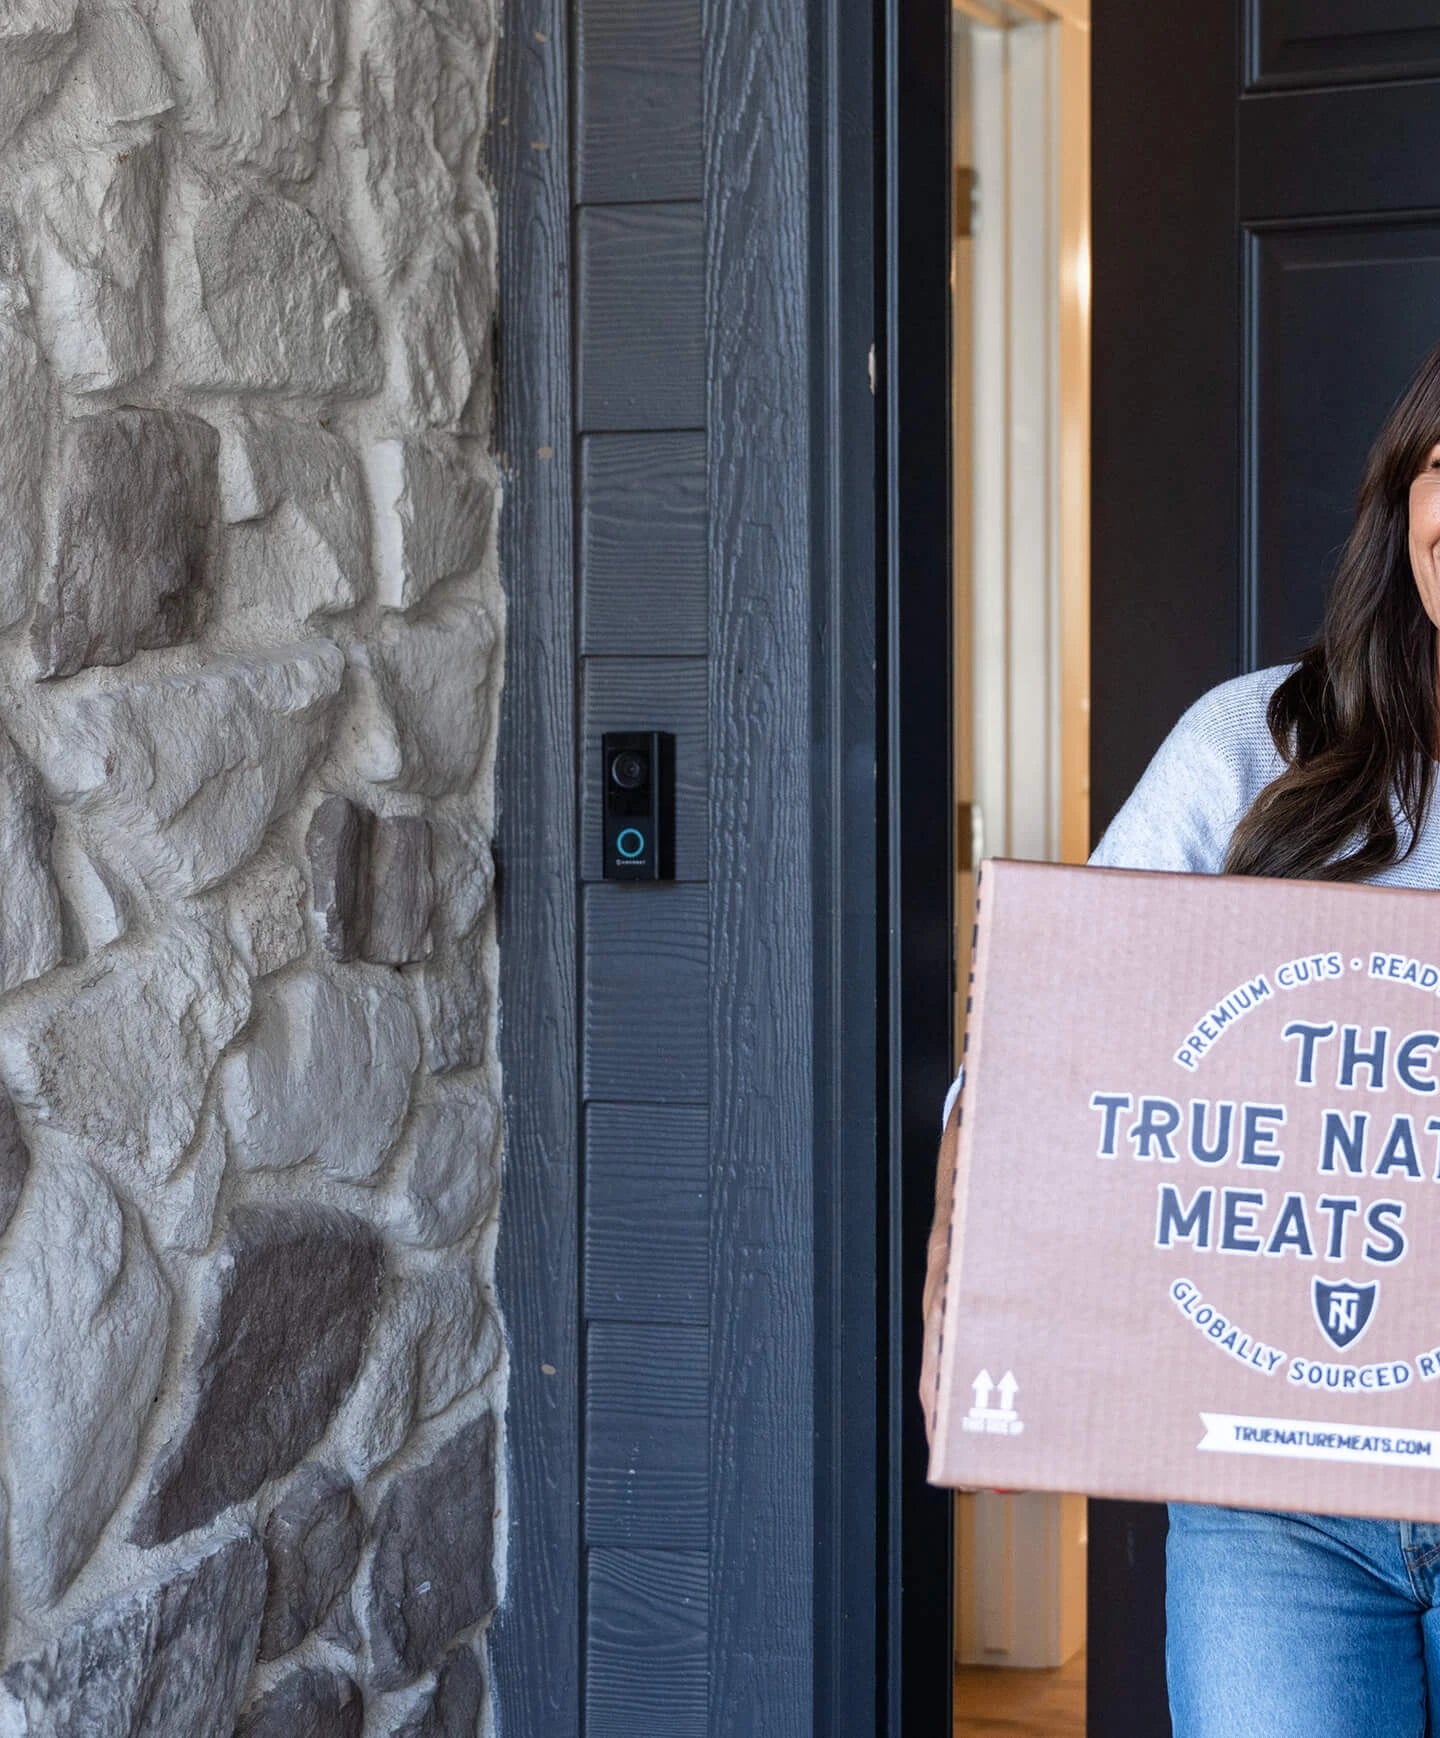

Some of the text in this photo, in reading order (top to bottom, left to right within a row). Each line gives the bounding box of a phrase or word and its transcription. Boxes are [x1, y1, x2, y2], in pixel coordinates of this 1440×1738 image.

[1177, 978, 1270, 1066] PREMIUM
[1277, 954, 1342, 987] CUTS
[1285, 1024, 1440, 1092] THE
[1094, 1096, 1284, 1167] TRUE
[1158, 1187, 1404, 1263] MEATS
[1172, 1280, 1280, 1371] GLOBALLY
[1290, 1361, 1410, 1388] SOURCED
[1233, 1425, 1432, 1456] TRUENATUREMEATS.COM
